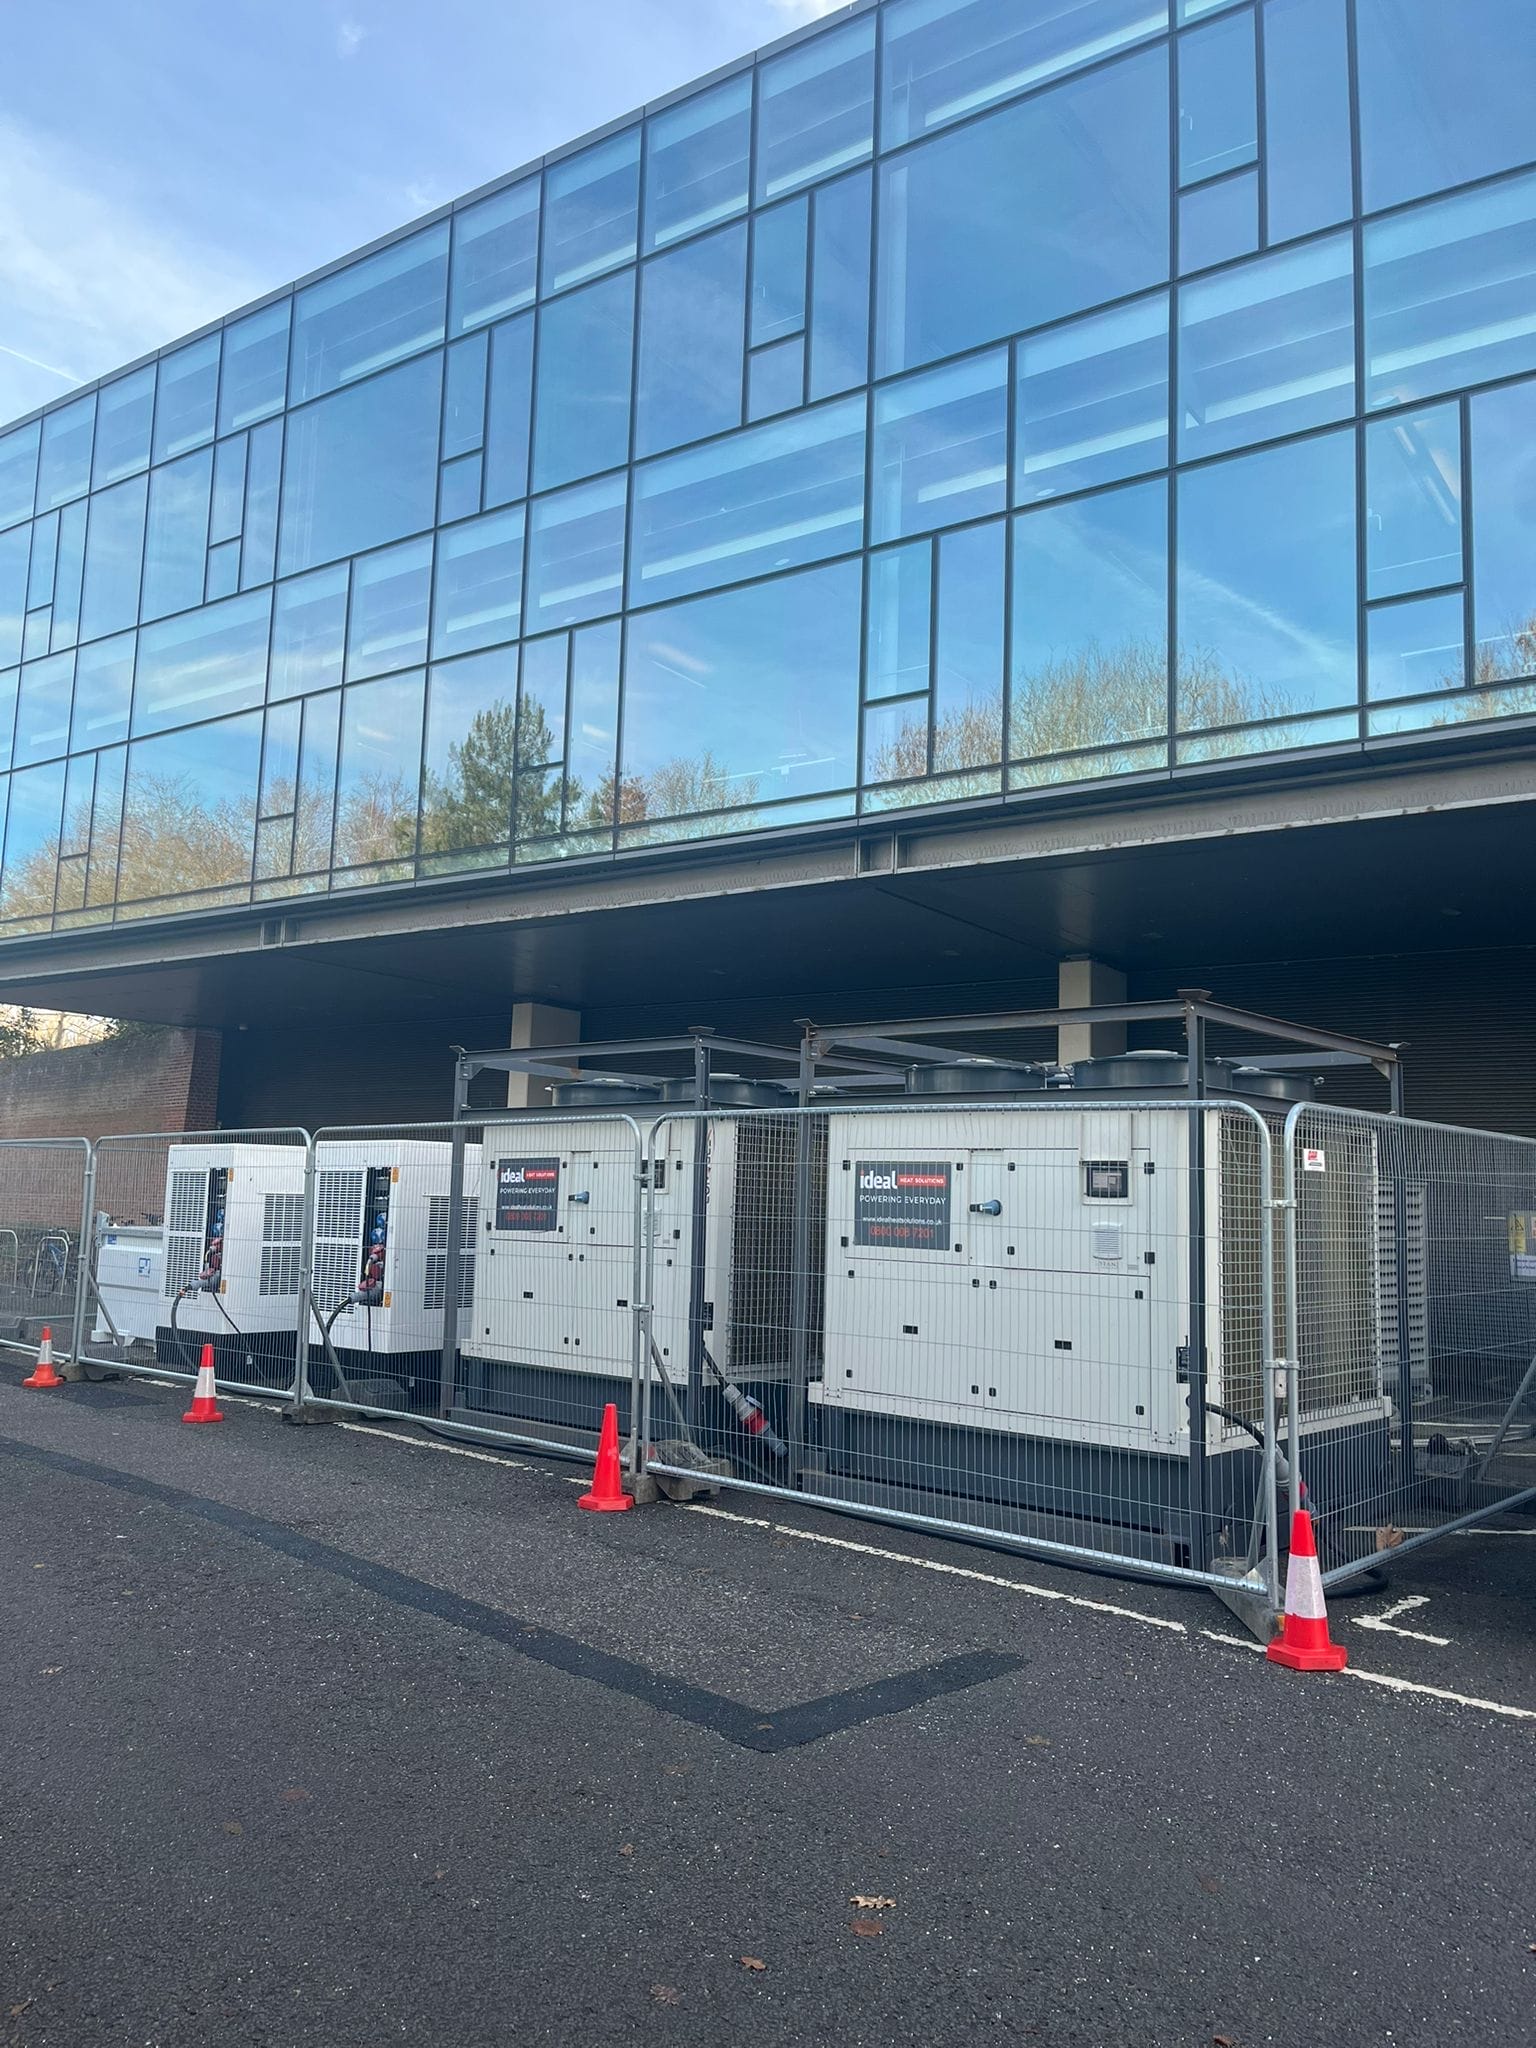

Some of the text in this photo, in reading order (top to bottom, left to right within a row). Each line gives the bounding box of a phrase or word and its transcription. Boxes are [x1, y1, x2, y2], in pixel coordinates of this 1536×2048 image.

[500, 1167, 525, 1183] ideal
[860, 1169, 898, 1190] ideal
[860, 1195, 946, 1205] POWERING EVERYDAY
